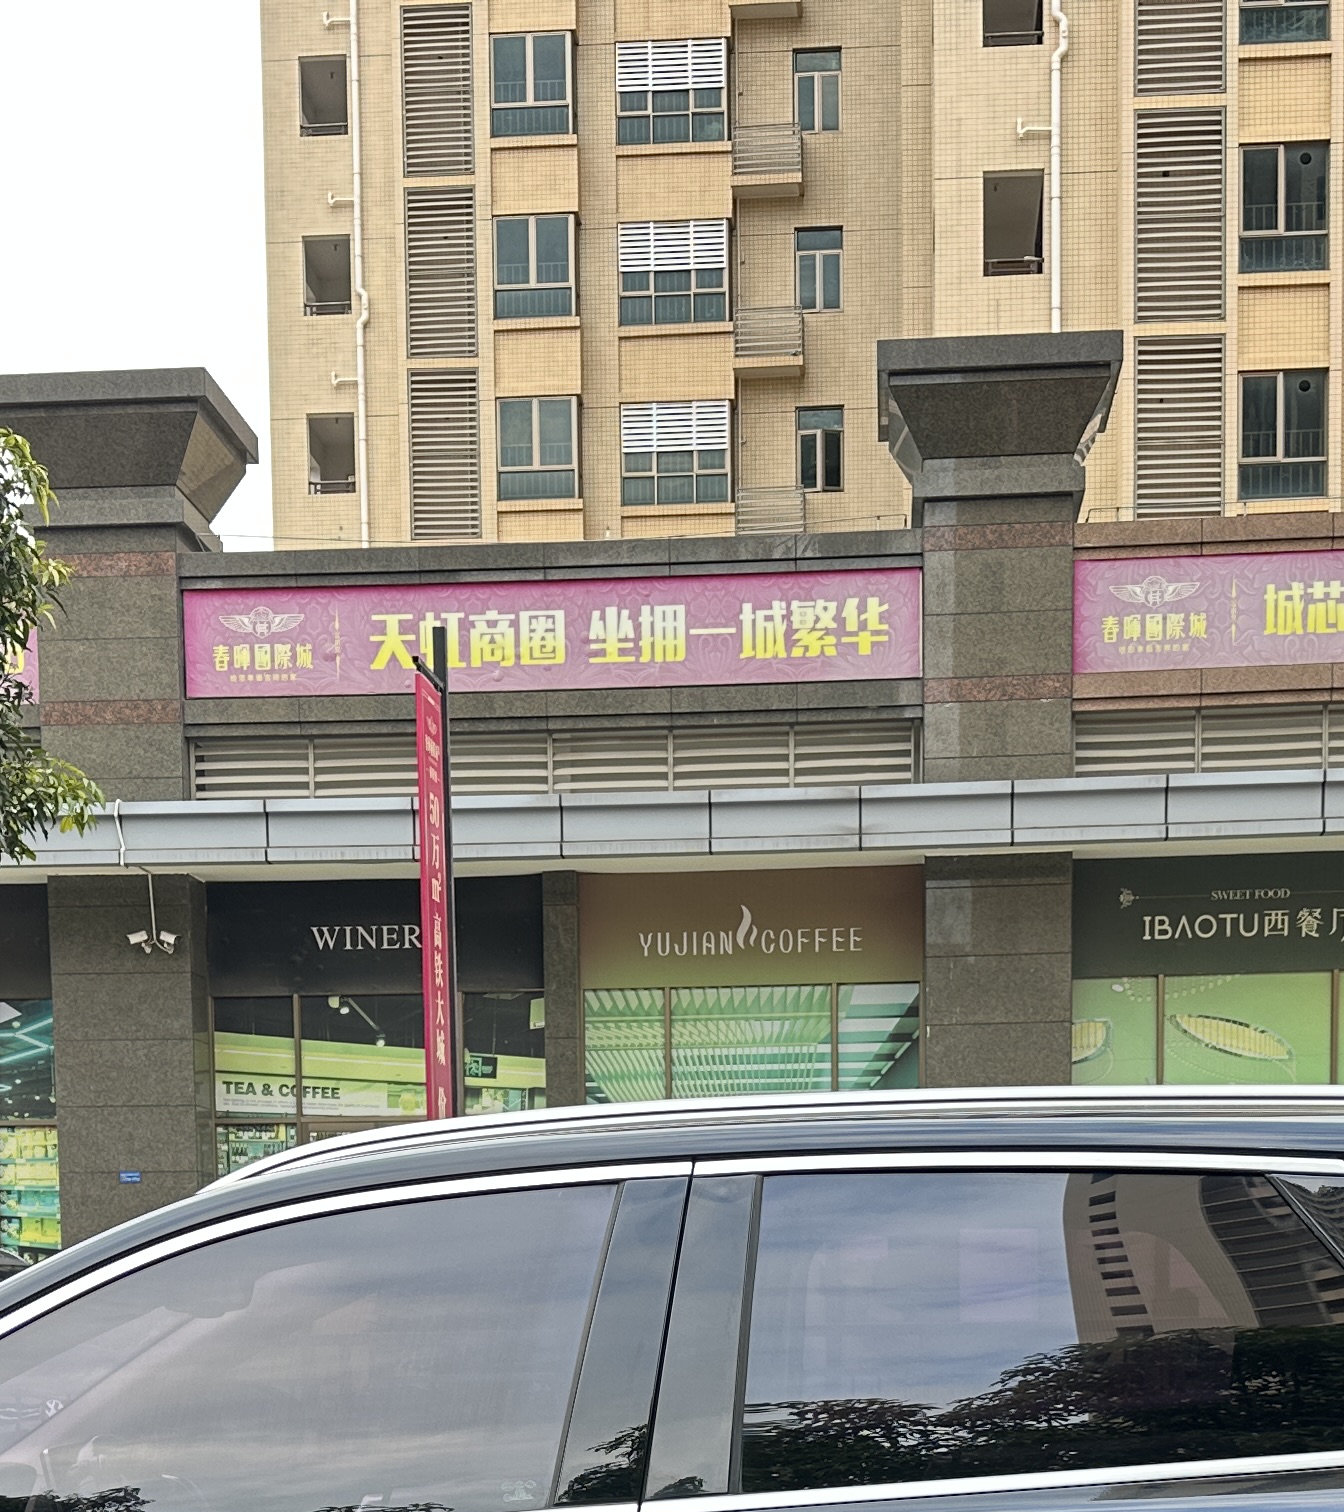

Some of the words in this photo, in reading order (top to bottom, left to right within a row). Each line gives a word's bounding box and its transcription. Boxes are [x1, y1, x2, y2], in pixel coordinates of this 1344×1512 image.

[369, 609, 566, 669] 天虹商圈
[588, 597, 889, 663] 坐拥一城繁华
[1210, 889, 1251, 901] SWEET
[1255, 888, 1291, 900] FOOD
[310, 924, 423, 951] WINER
[639, 931, 733, 956] YUJIAN
[761, 927, 863, 953] COFFEE
[222, 1080, 257, 1096] TEA
[262, 1083, 274, 1097] &
[278, 1083, 341, 1100] COFFEE
